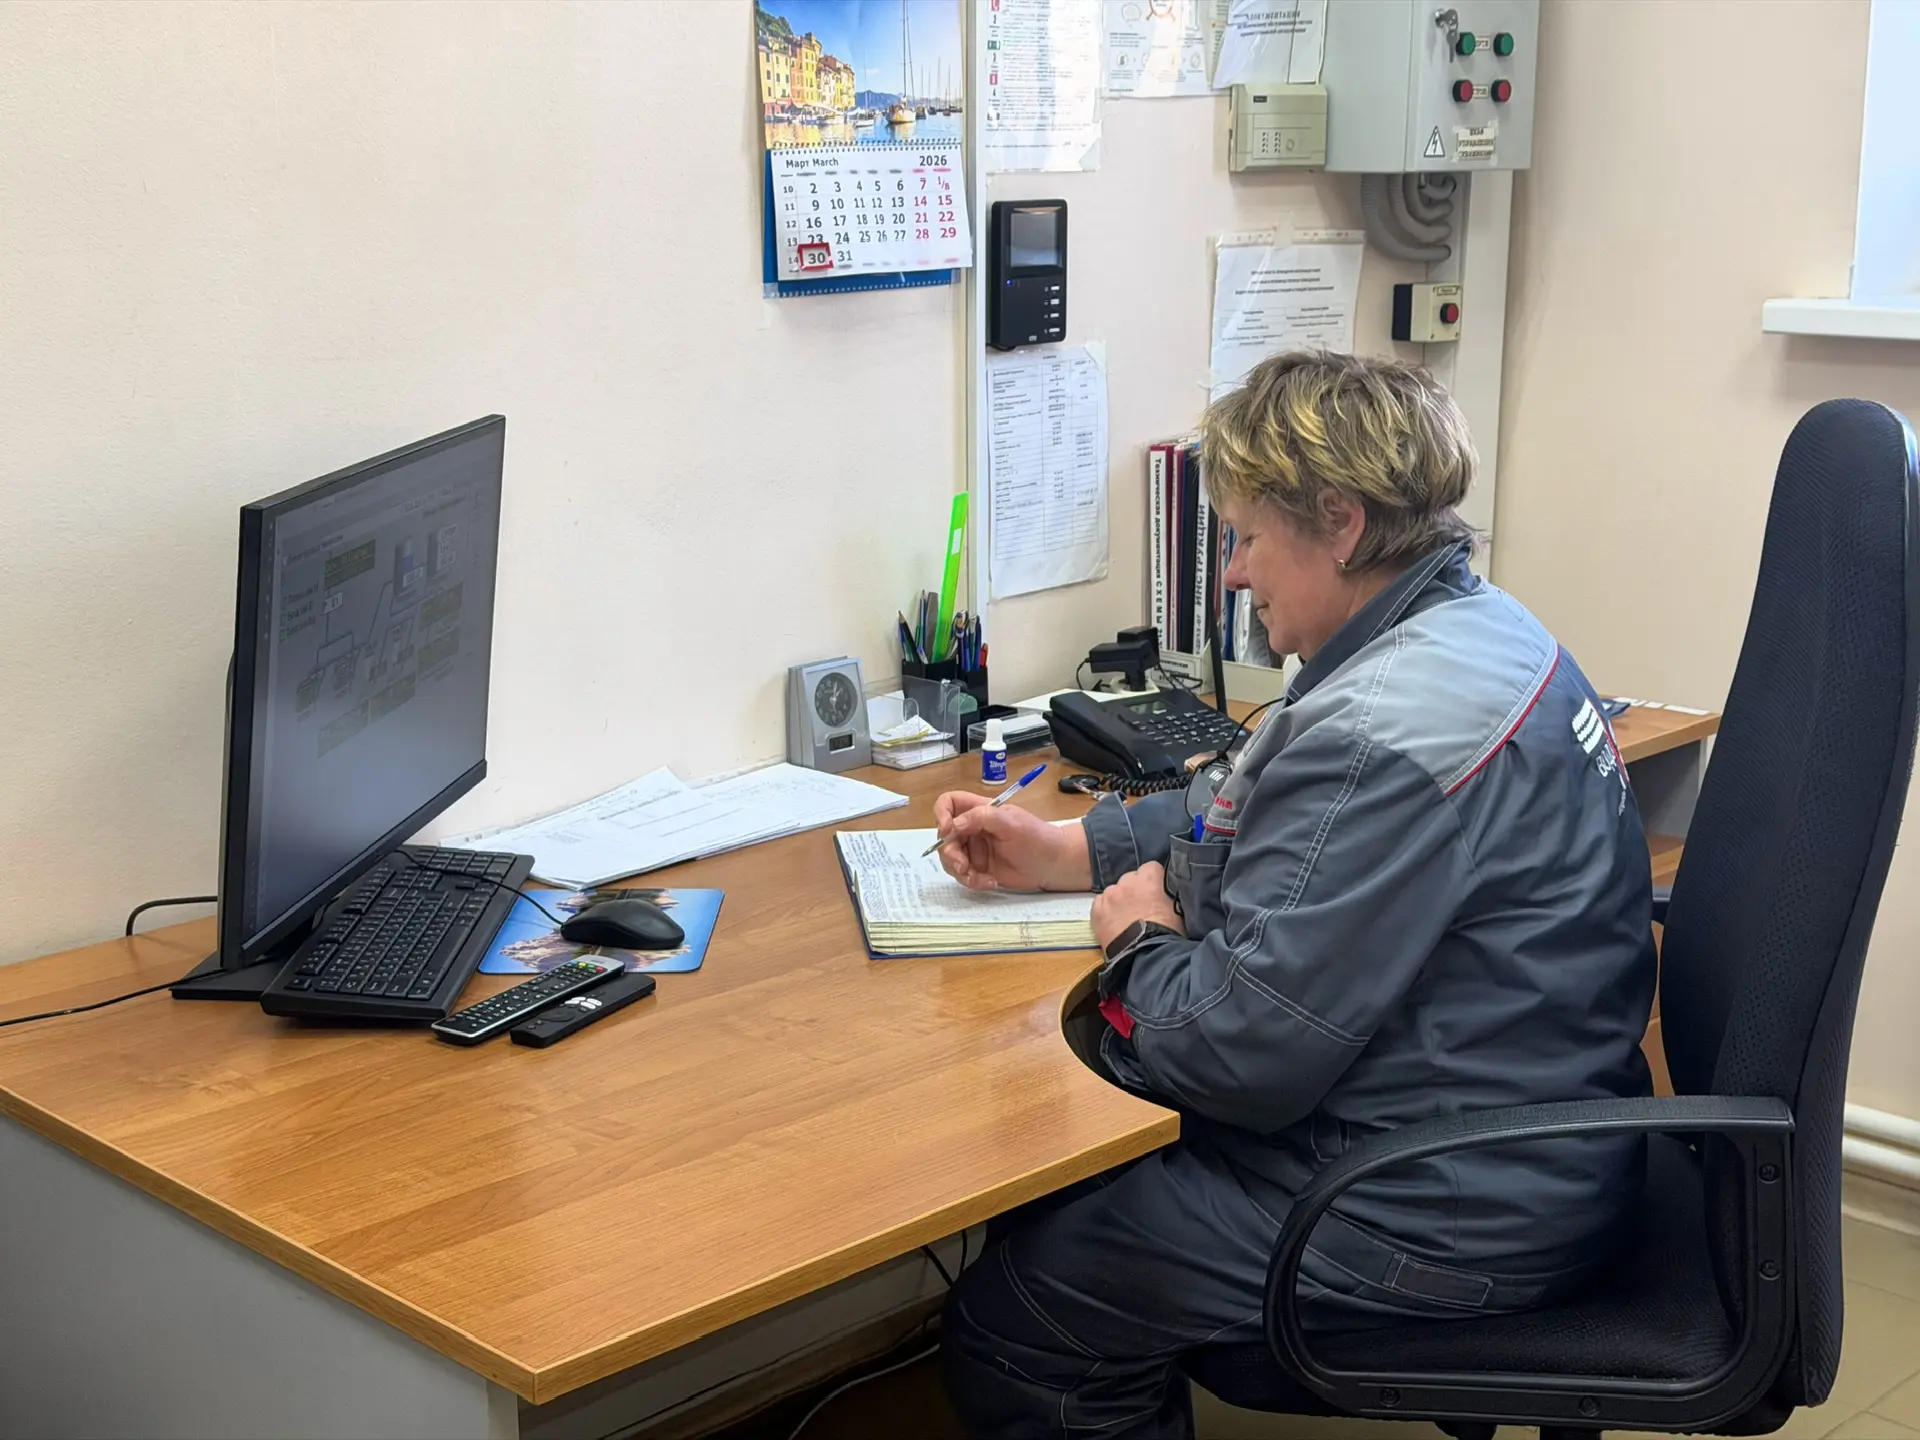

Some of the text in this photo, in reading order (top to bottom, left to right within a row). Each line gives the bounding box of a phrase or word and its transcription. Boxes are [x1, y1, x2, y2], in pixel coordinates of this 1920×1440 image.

[786, 159, 809, 168] Март
[813, 158, 839, 166] March
[920, 155, 947, 166] 2026
[783, 185, 793, 193] 10
[810, 183, 817, 194] 2
[834, 181, 841, 192] 3
[857, 181, 862, 191] 4
[875, 181, 881, 191] 5
[897, 180, 904, 191] 6
[920, 180, 926, 189] 7
[812, 200, 819, 211] 9
[830, 199, 844, 209] 10
[854, 198, 865, 208] 11
[872, 198, 882, 208] 12
[892, 197, 904, 207] 13
[914, 196, 927, 206] 14
[938, 195, 952, 205] 15
[806, 217, 822, 228] 16
[833, 215, 846, 226] 17
[857, 214, 868, 225] 18
[875, 214, 884, 224] 19
[893, 213, 905, 224] 20
[915, 213, 928, 223] 21
[939, 211, 955, 222] 22
[788, 228, 956, 246] 13 23 24 25 26 27 28 29
[808, 252, 825, 264] 30
[838, 250, 852, 262] 31
[1194, 504, 1206, 607] ИНСТРУКЦИИ
